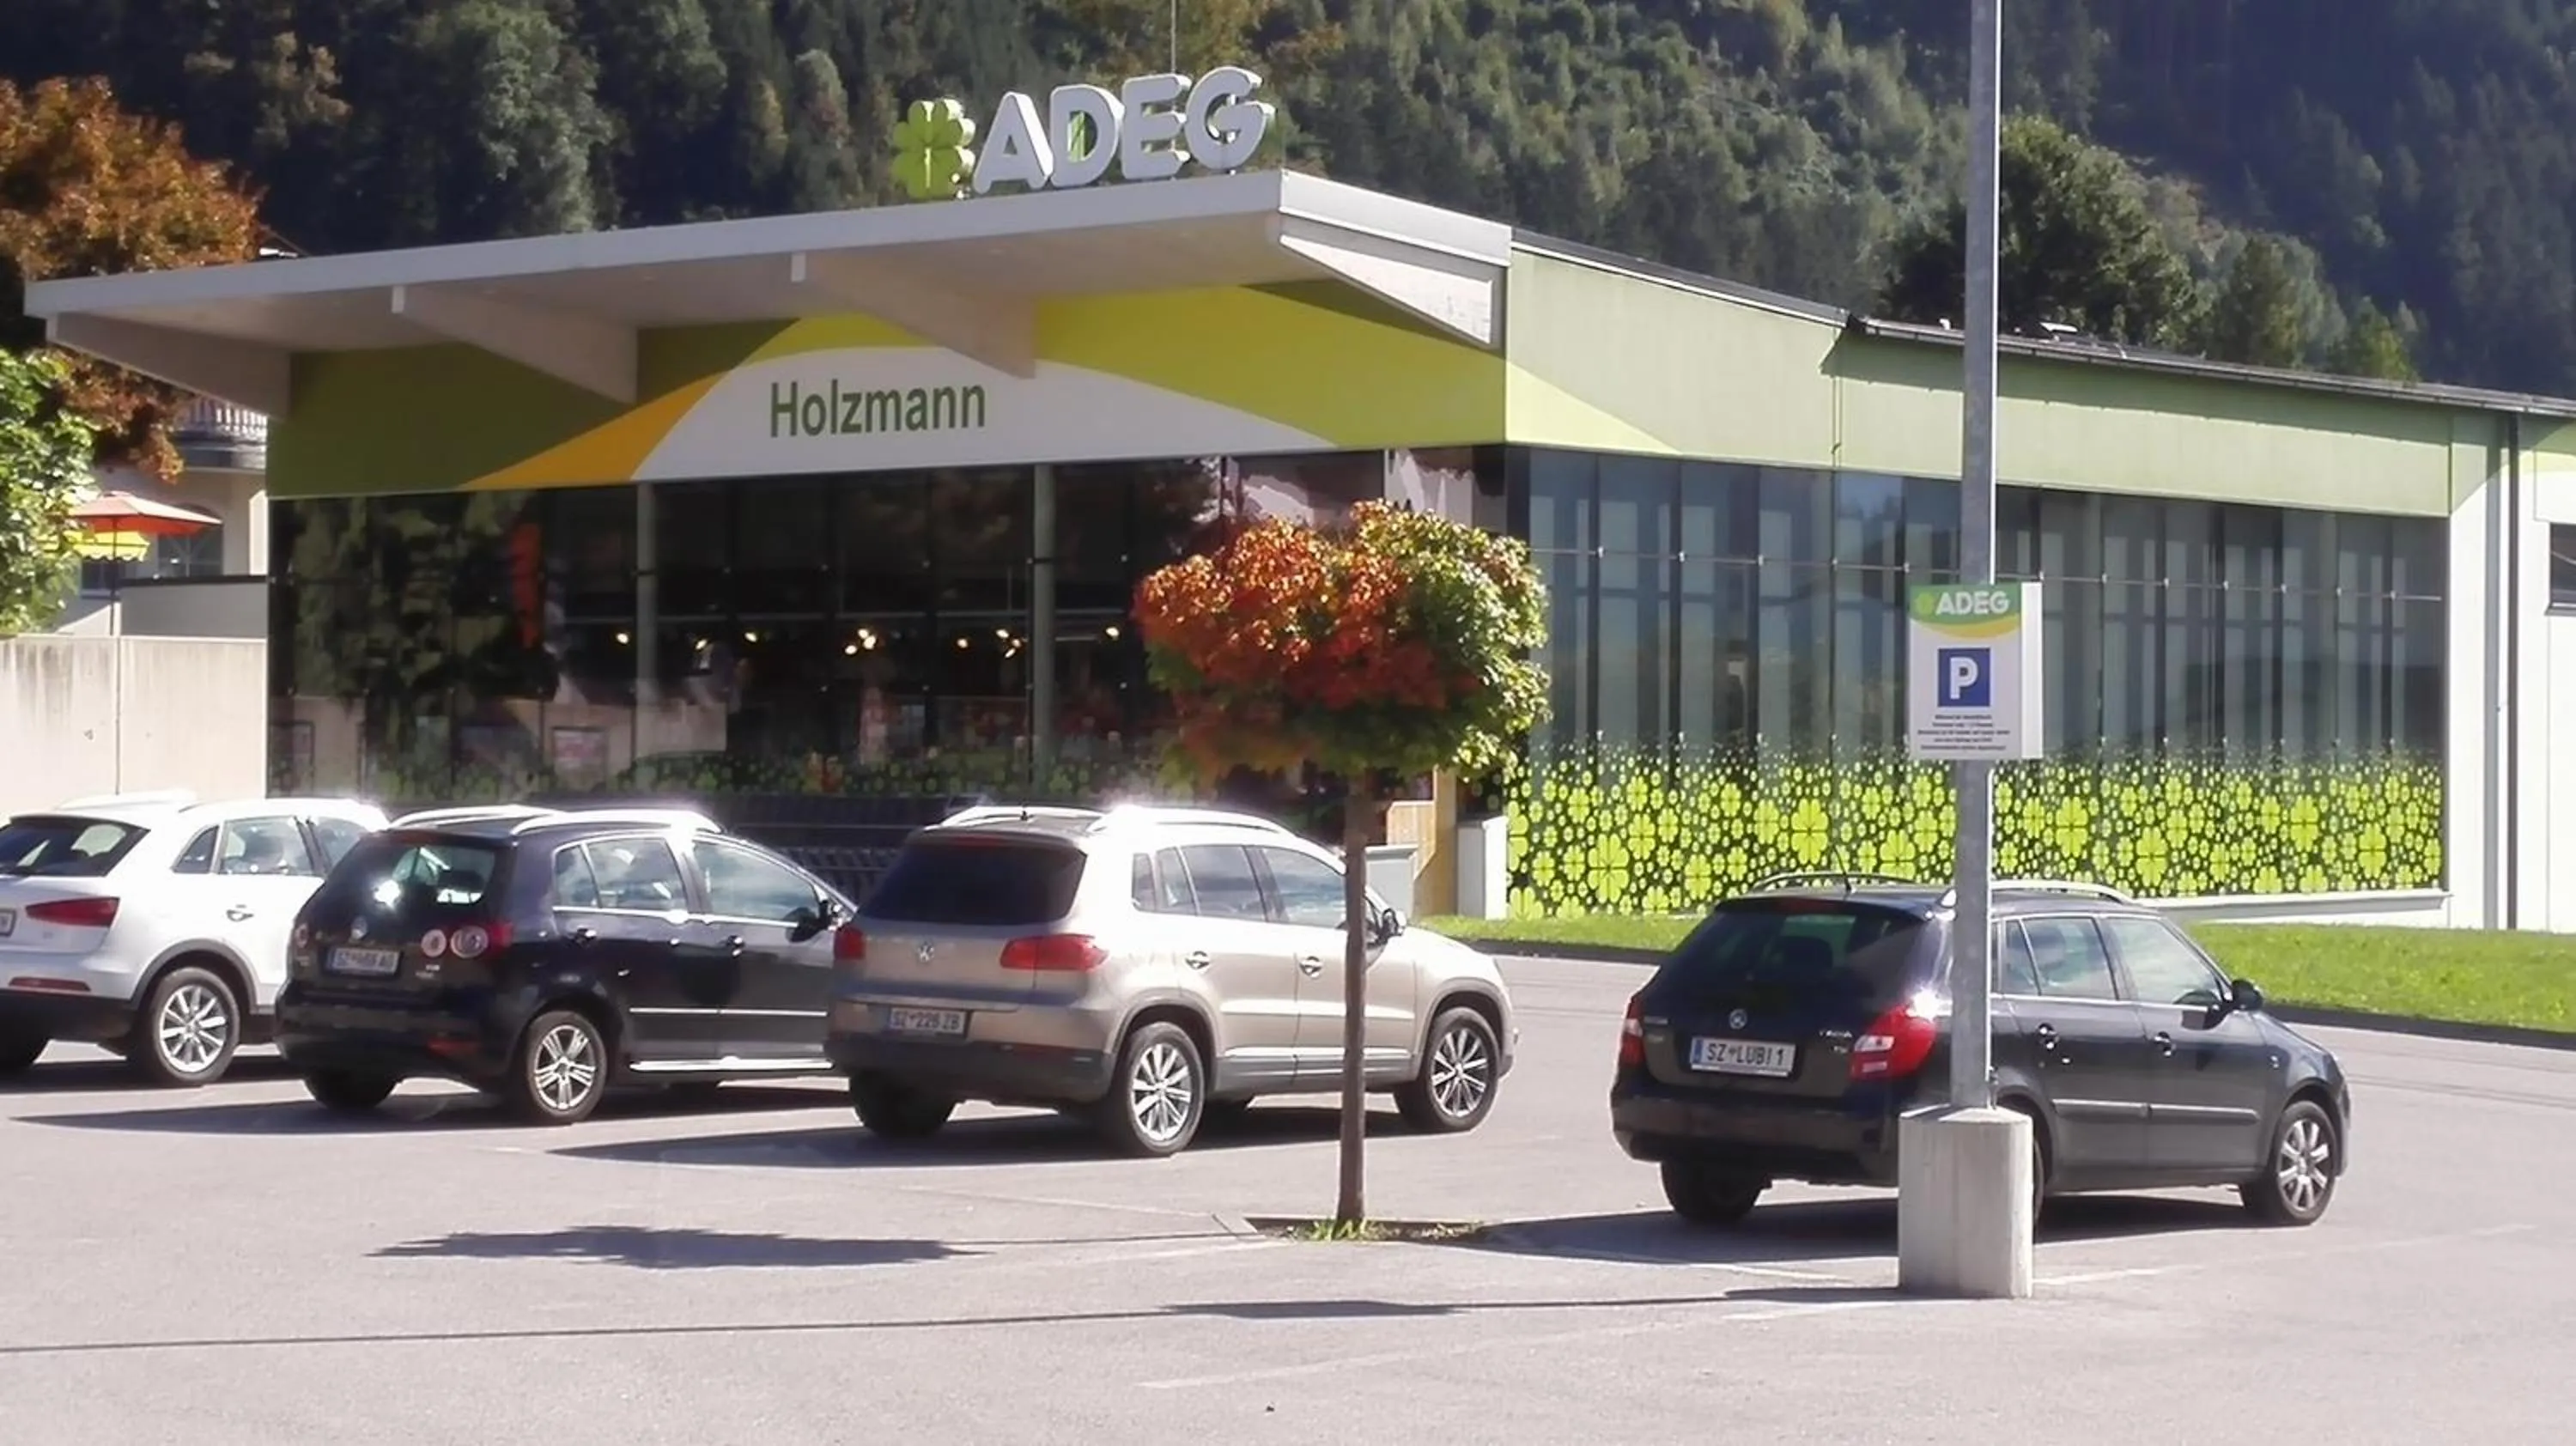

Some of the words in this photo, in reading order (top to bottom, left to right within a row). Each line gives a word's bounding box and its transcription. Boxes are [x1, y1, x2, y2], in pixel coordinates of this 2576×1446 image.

[973, 65, 1277, 194] ADEG
[770, 379, 985, 438] Holzmann
[1935, 590, 2010, 615] ADEG
[1950, 657, 1978, 700] P
